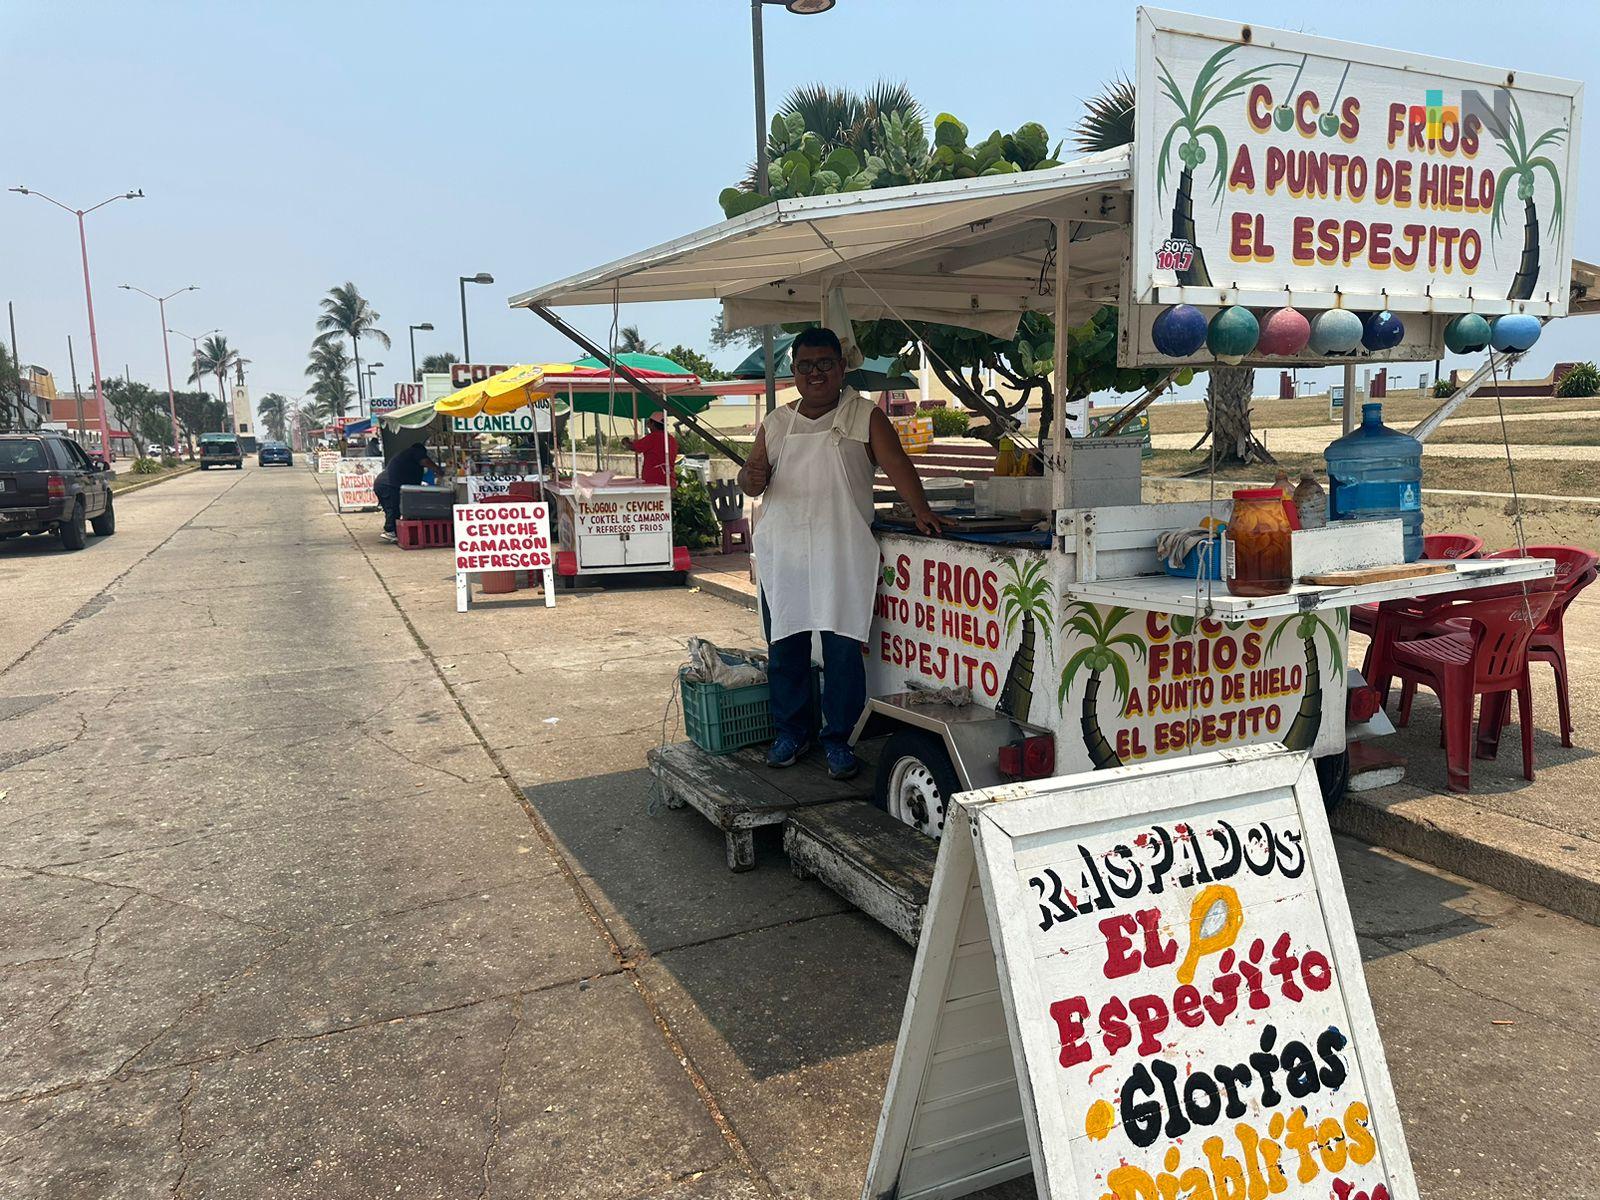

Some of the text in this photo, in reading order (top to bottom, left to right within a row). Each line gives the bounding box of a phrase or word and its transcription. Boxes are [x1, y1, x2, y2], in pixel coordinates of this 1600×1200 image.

[1387, 103, 1482, 158] FRIOS
[1228, 143, 1495, 214] A PUNTO DE HIELO
[1156, 250, 1194, 270] 101.7
[1164, 241, 1186, 252] SOY
[1230, 212, 1481, 274] EL ESPEJITO
[454, 416, 533, 431] EL CANELO
[519, 474, 526, 482] Y
[456, 507, 545, 521] TEGOGOLO
[580, 512, 670, 525] Y COKTEL DE CAMARON
[626, 500, 664, 512] CEVICHE
[458, 535, 547, 552] CAMARÓN
[466, 522, 538, 536] CEVICHE
[596, 525, 635, 534] REFRESCOS
[640, 524, 663, 532] FRIOS
[457, 552, 550, 568] REFRESCOS
[923, 559, 998, 614] FRIOS
[915, 602, 935, 632] DE
[941, 608, 1000, 650] HIELO
[881, 631, 999, 697] ESPEJITO
[1148, 632, 1262, 683] FRIOS
[1125, 664, 1302, 719] A PUNTO DE HIELO
[1116, 703, 1281, 762] EL ESPEJITO
[1028, 818, 1306, 932] RASPADOS
[1099, 906, 1180, 980] EL
